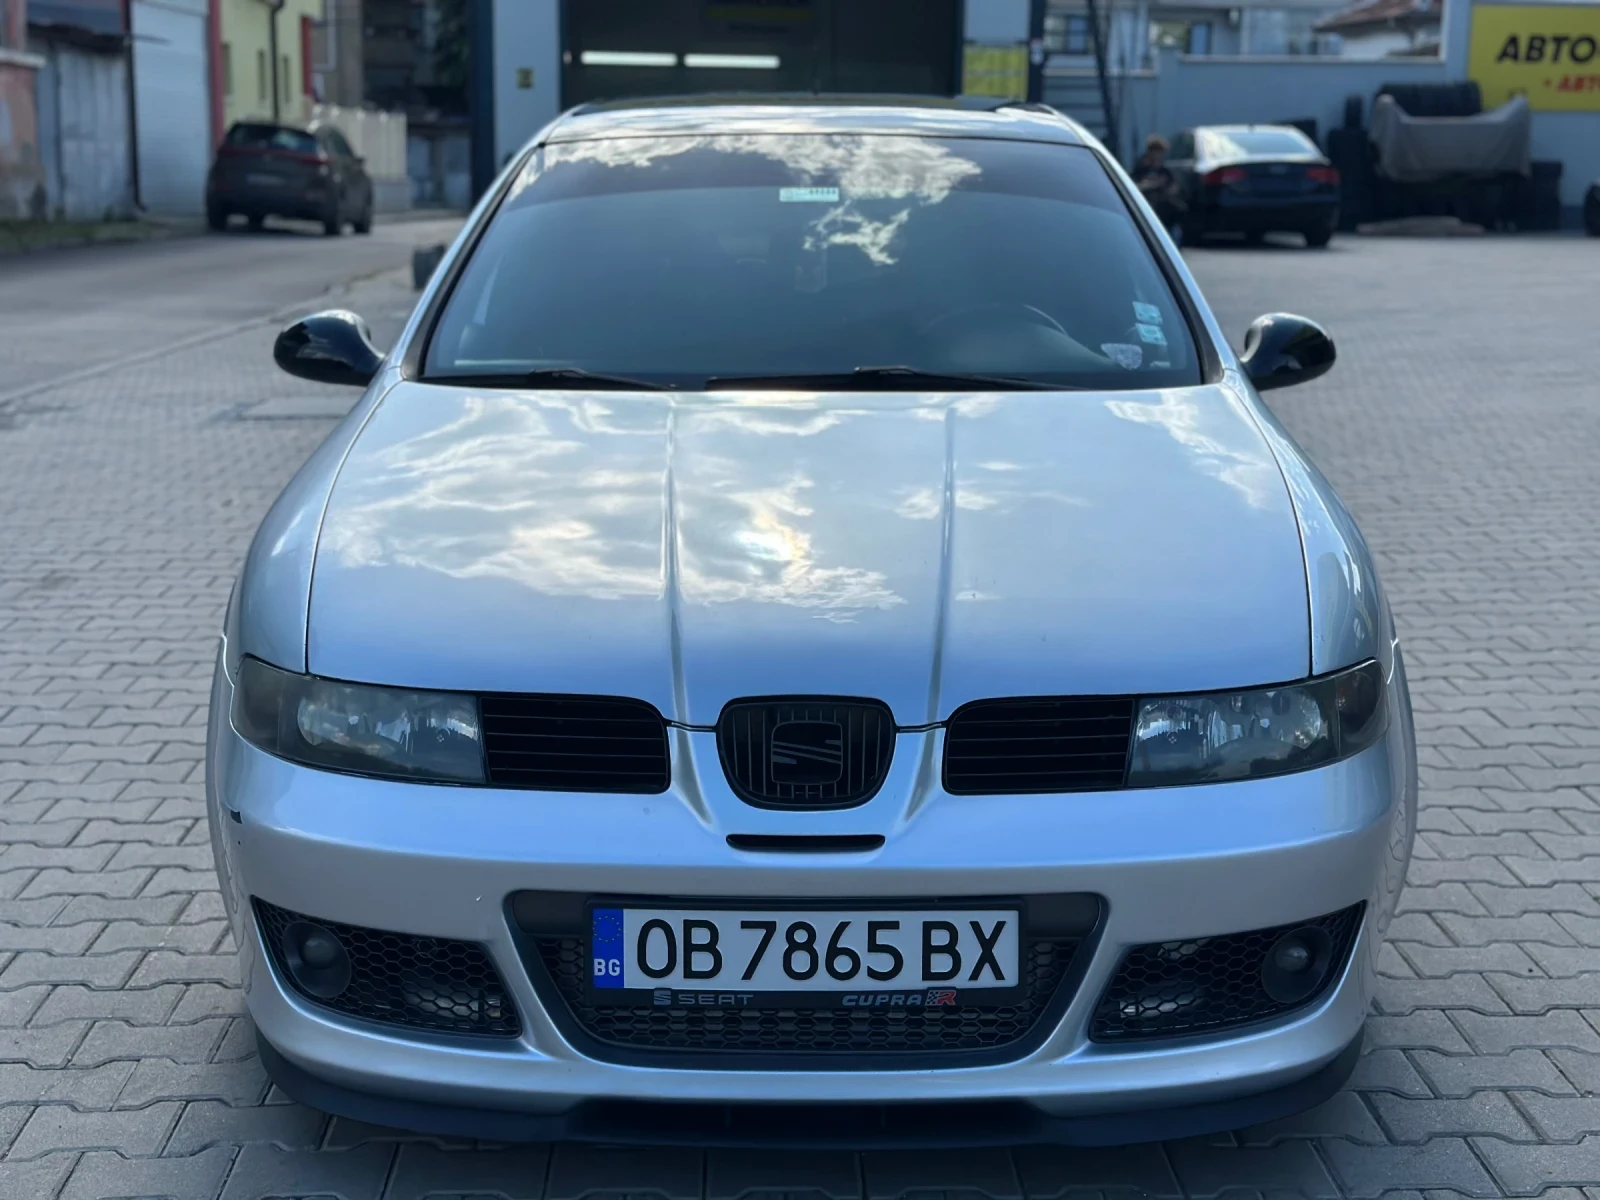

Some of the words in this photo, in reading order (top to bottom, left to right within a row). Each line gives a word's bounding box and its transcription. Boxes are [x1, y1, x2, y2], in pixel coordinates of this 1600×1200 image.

[636, 918, 723, 979] OB
[740, 920, 904, 981] 7865
[921, 920, 1006, 981] BX
[593, 958, 620, 977] BG
[678, 994, 754, 1005] SEAT
[842, 994, 922, 1006] CUPRA
